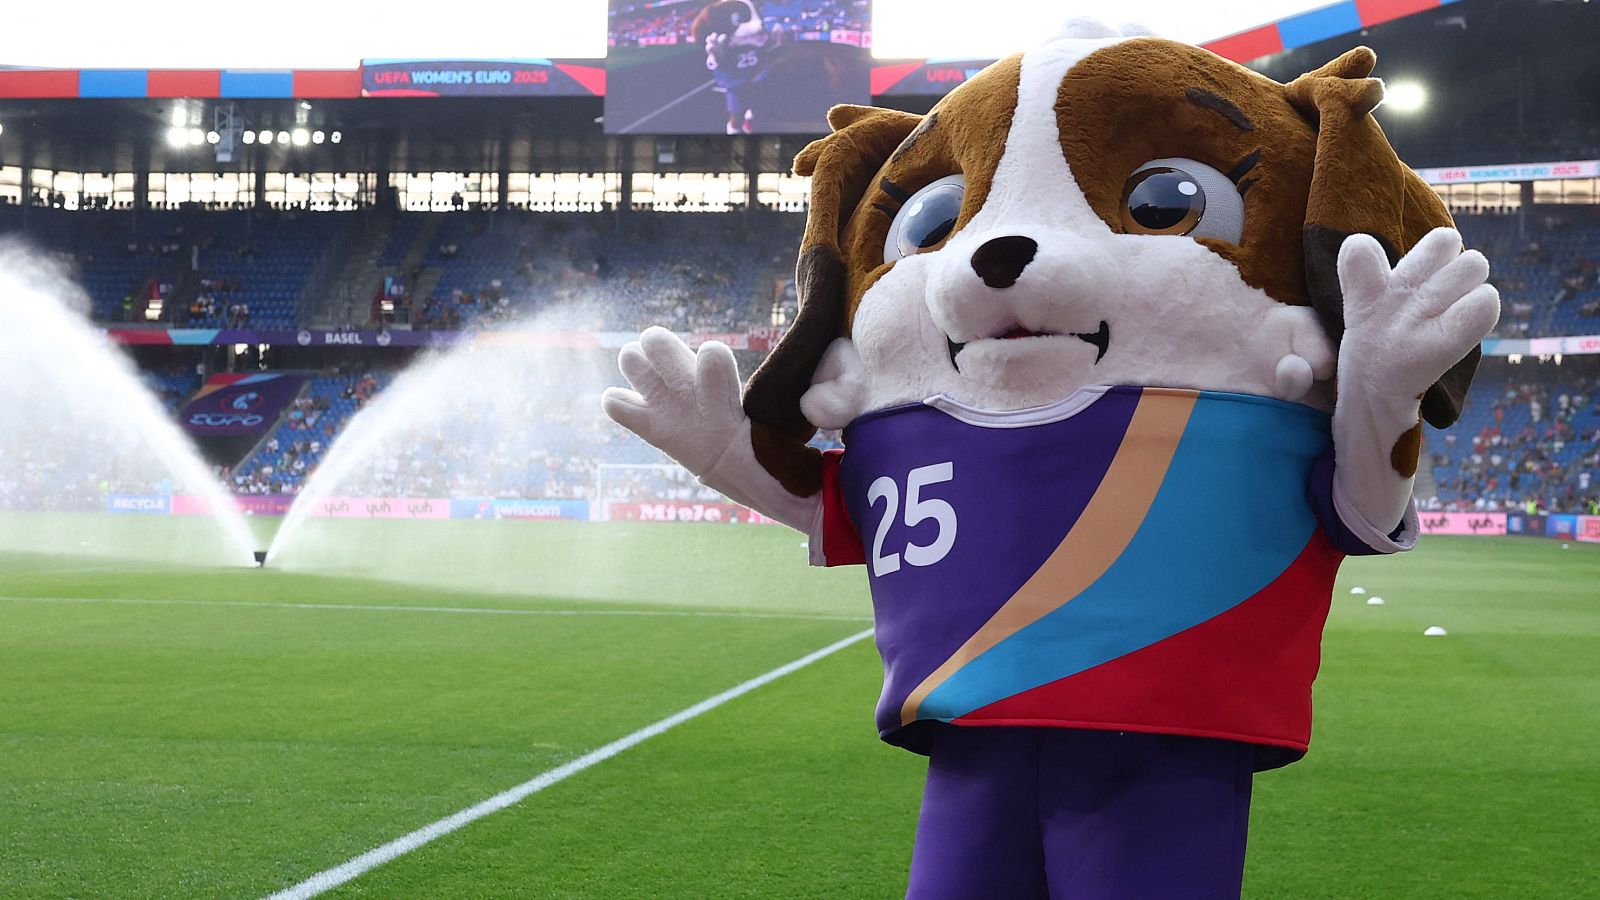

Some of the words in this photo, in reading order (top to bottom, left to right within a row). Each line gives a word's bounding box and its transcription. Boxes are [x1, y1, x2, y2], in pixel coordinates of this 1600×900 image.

[736, 50, 758, 68] 25
[374, 70, 410, 84] UEFA
[411, 70, 473, 84] WOMEN'S
[475, 70, 511, 84] EURO
[513, 70, 548, 84] 2025
[926, 69, 965, 82] UEFA
[325, 332, 362, 344] BASEL
[112, 498, 165, 509] RECYCLE
[325, 501, 349, 515] yuh
[366, 500, 391, 516] yuh
[408, 500, 433, 516] yuh
[493, 505, 560, 516] swisscom
[639, 503, 722, 521] Miele
[867, 461, 957, 577] 25
[1423, 515, 1450, 533] yuh
[1468, 515, 1494, 533] yuh
